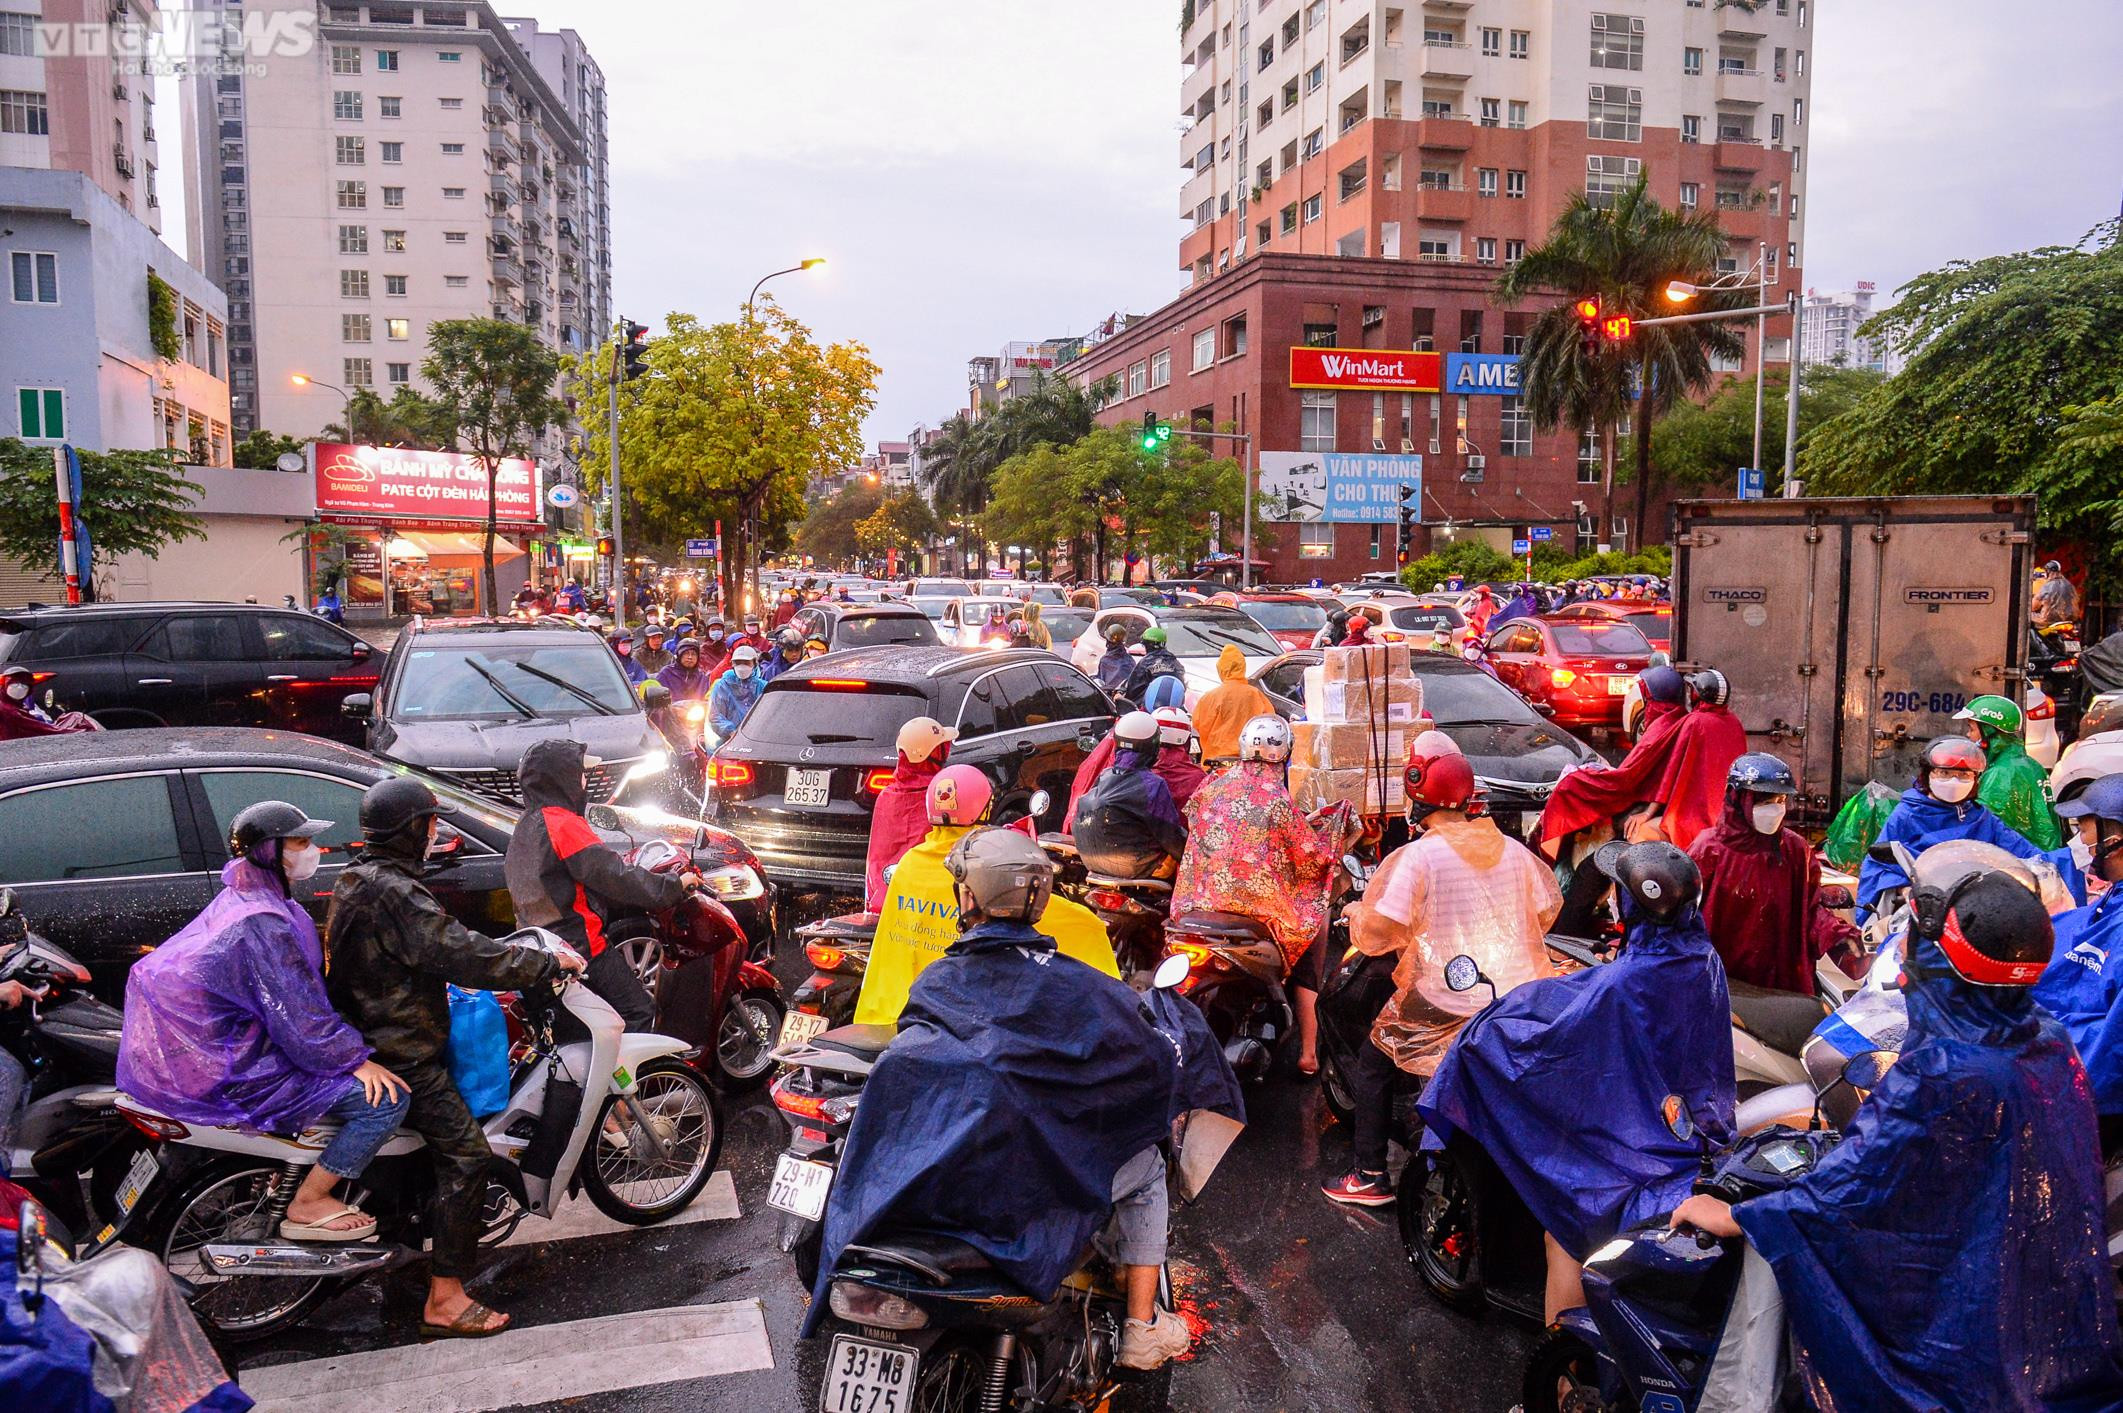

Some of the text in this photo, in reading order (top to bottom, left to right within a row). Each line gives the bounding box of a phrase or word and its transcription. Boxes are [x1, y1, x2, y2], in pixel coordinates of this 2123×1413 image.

[1857, 281, 1875, 290] UDIC
[1607, 317, 1630, 337] 47
[1321, 355, 1404, 378] WinMart
[1330, 456, 1420, 478] VĂN PHÒNG
[331, 483, 368, 492] BAMIDELI
[381, 484, 415, 496] PATE
[416, 484, 440, 500] CỘT
[1334, 483, 1366, 502] CHO
[1709, 590, 1761, 600] THACO
[1909, 591, 1989, 600] FRONTIER
[1882, 691, 1985, 713] 29C-684
[1980, 708, 2004, 720] Grab
[798, 772, 820, 786] 30G
[787, 787, 827, 803] 265.37
[904, 897, 960, 920] AVIVA
[940, 928, 959, 941] hàn
[790, 1015, 821, 1035] 29-Y7
[782, 1161, 823, 1187] 29-H1
[863, 1325, 897, 1342] YAMAHA
[1640, 1375, 1676, 1389] HONDA
[839, 1380, 899, 1413] 1675
